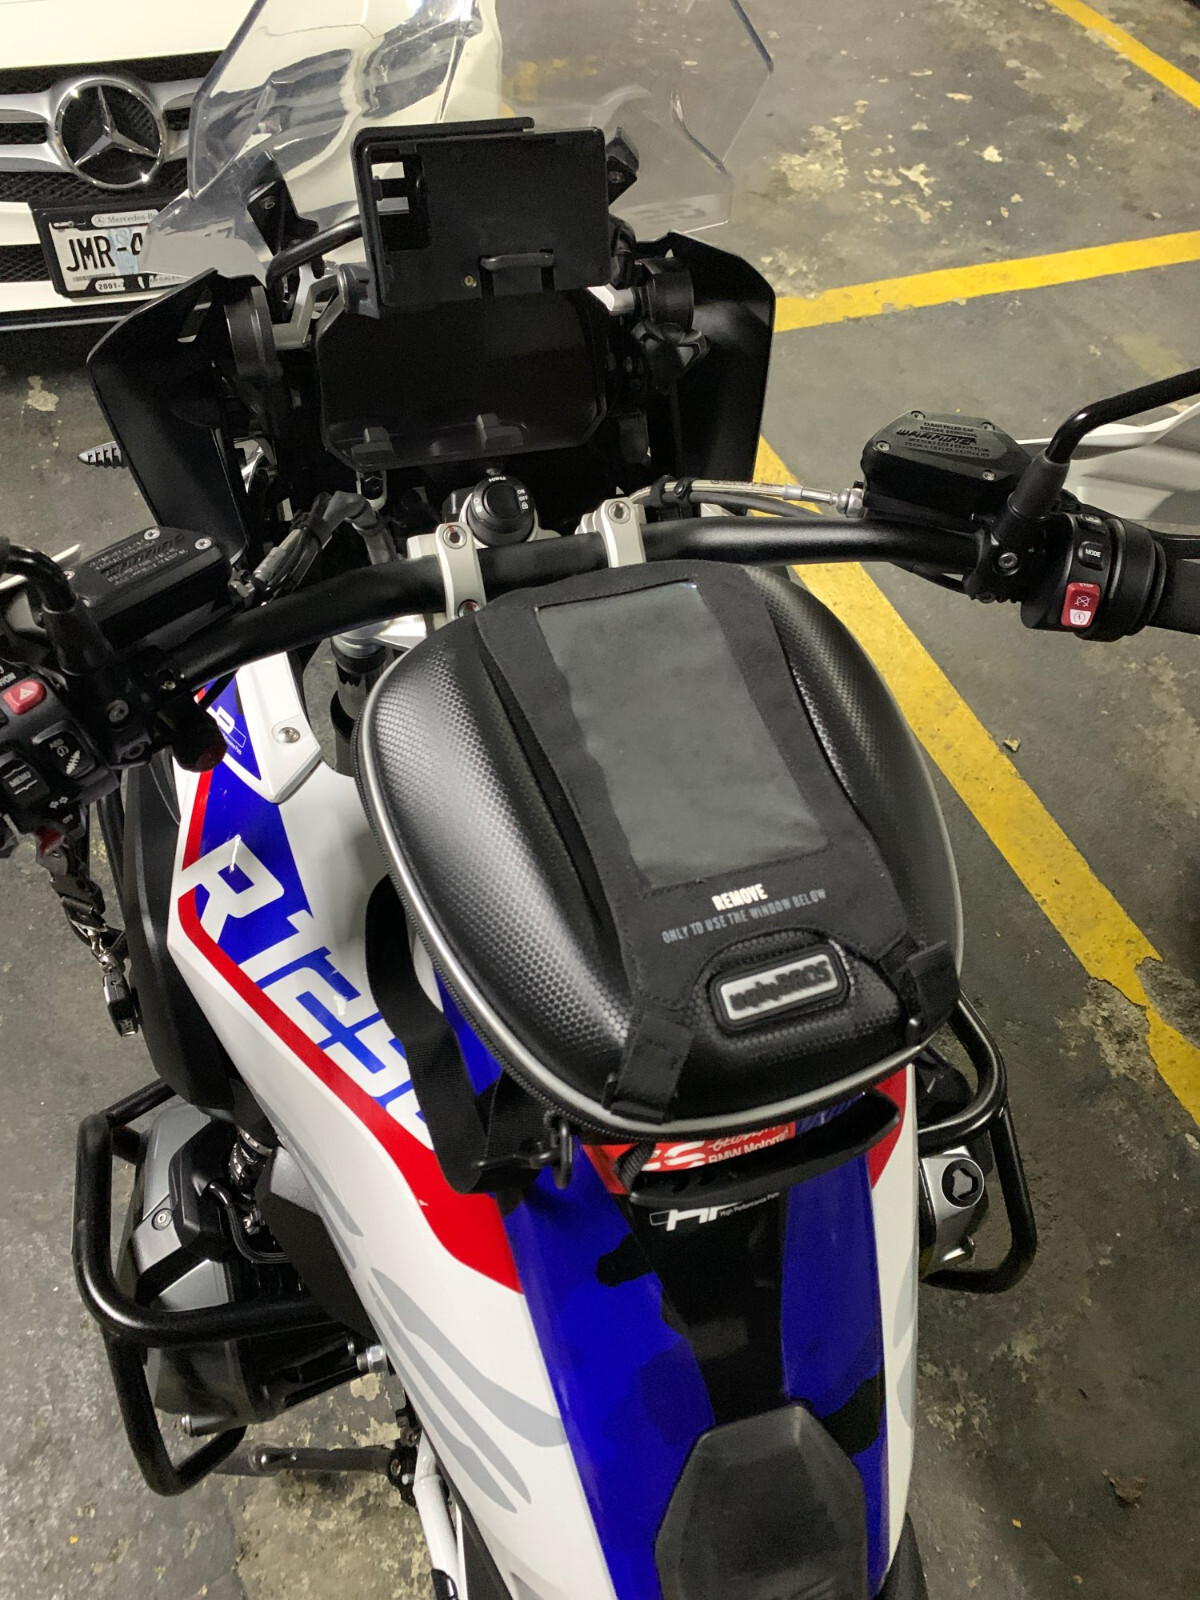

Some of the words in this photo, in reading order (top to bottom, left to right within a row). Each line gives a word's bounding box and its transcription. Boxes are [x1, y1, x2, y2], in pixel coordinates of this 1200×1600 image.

[1084, 548, 1101, 558] MODE
[8, 771, 32, 788] MENU
[711, 883, 769, 912] REMOVE
[661, 925, 689, 944] ONLY
[689, 921, 704, 936] TO
[704, 915, 728, 932] USE
[726, 909, 749, 925] THE
[748, 898, 792, 919] WINDOW
[791, 888, 827, 908] BELOW
